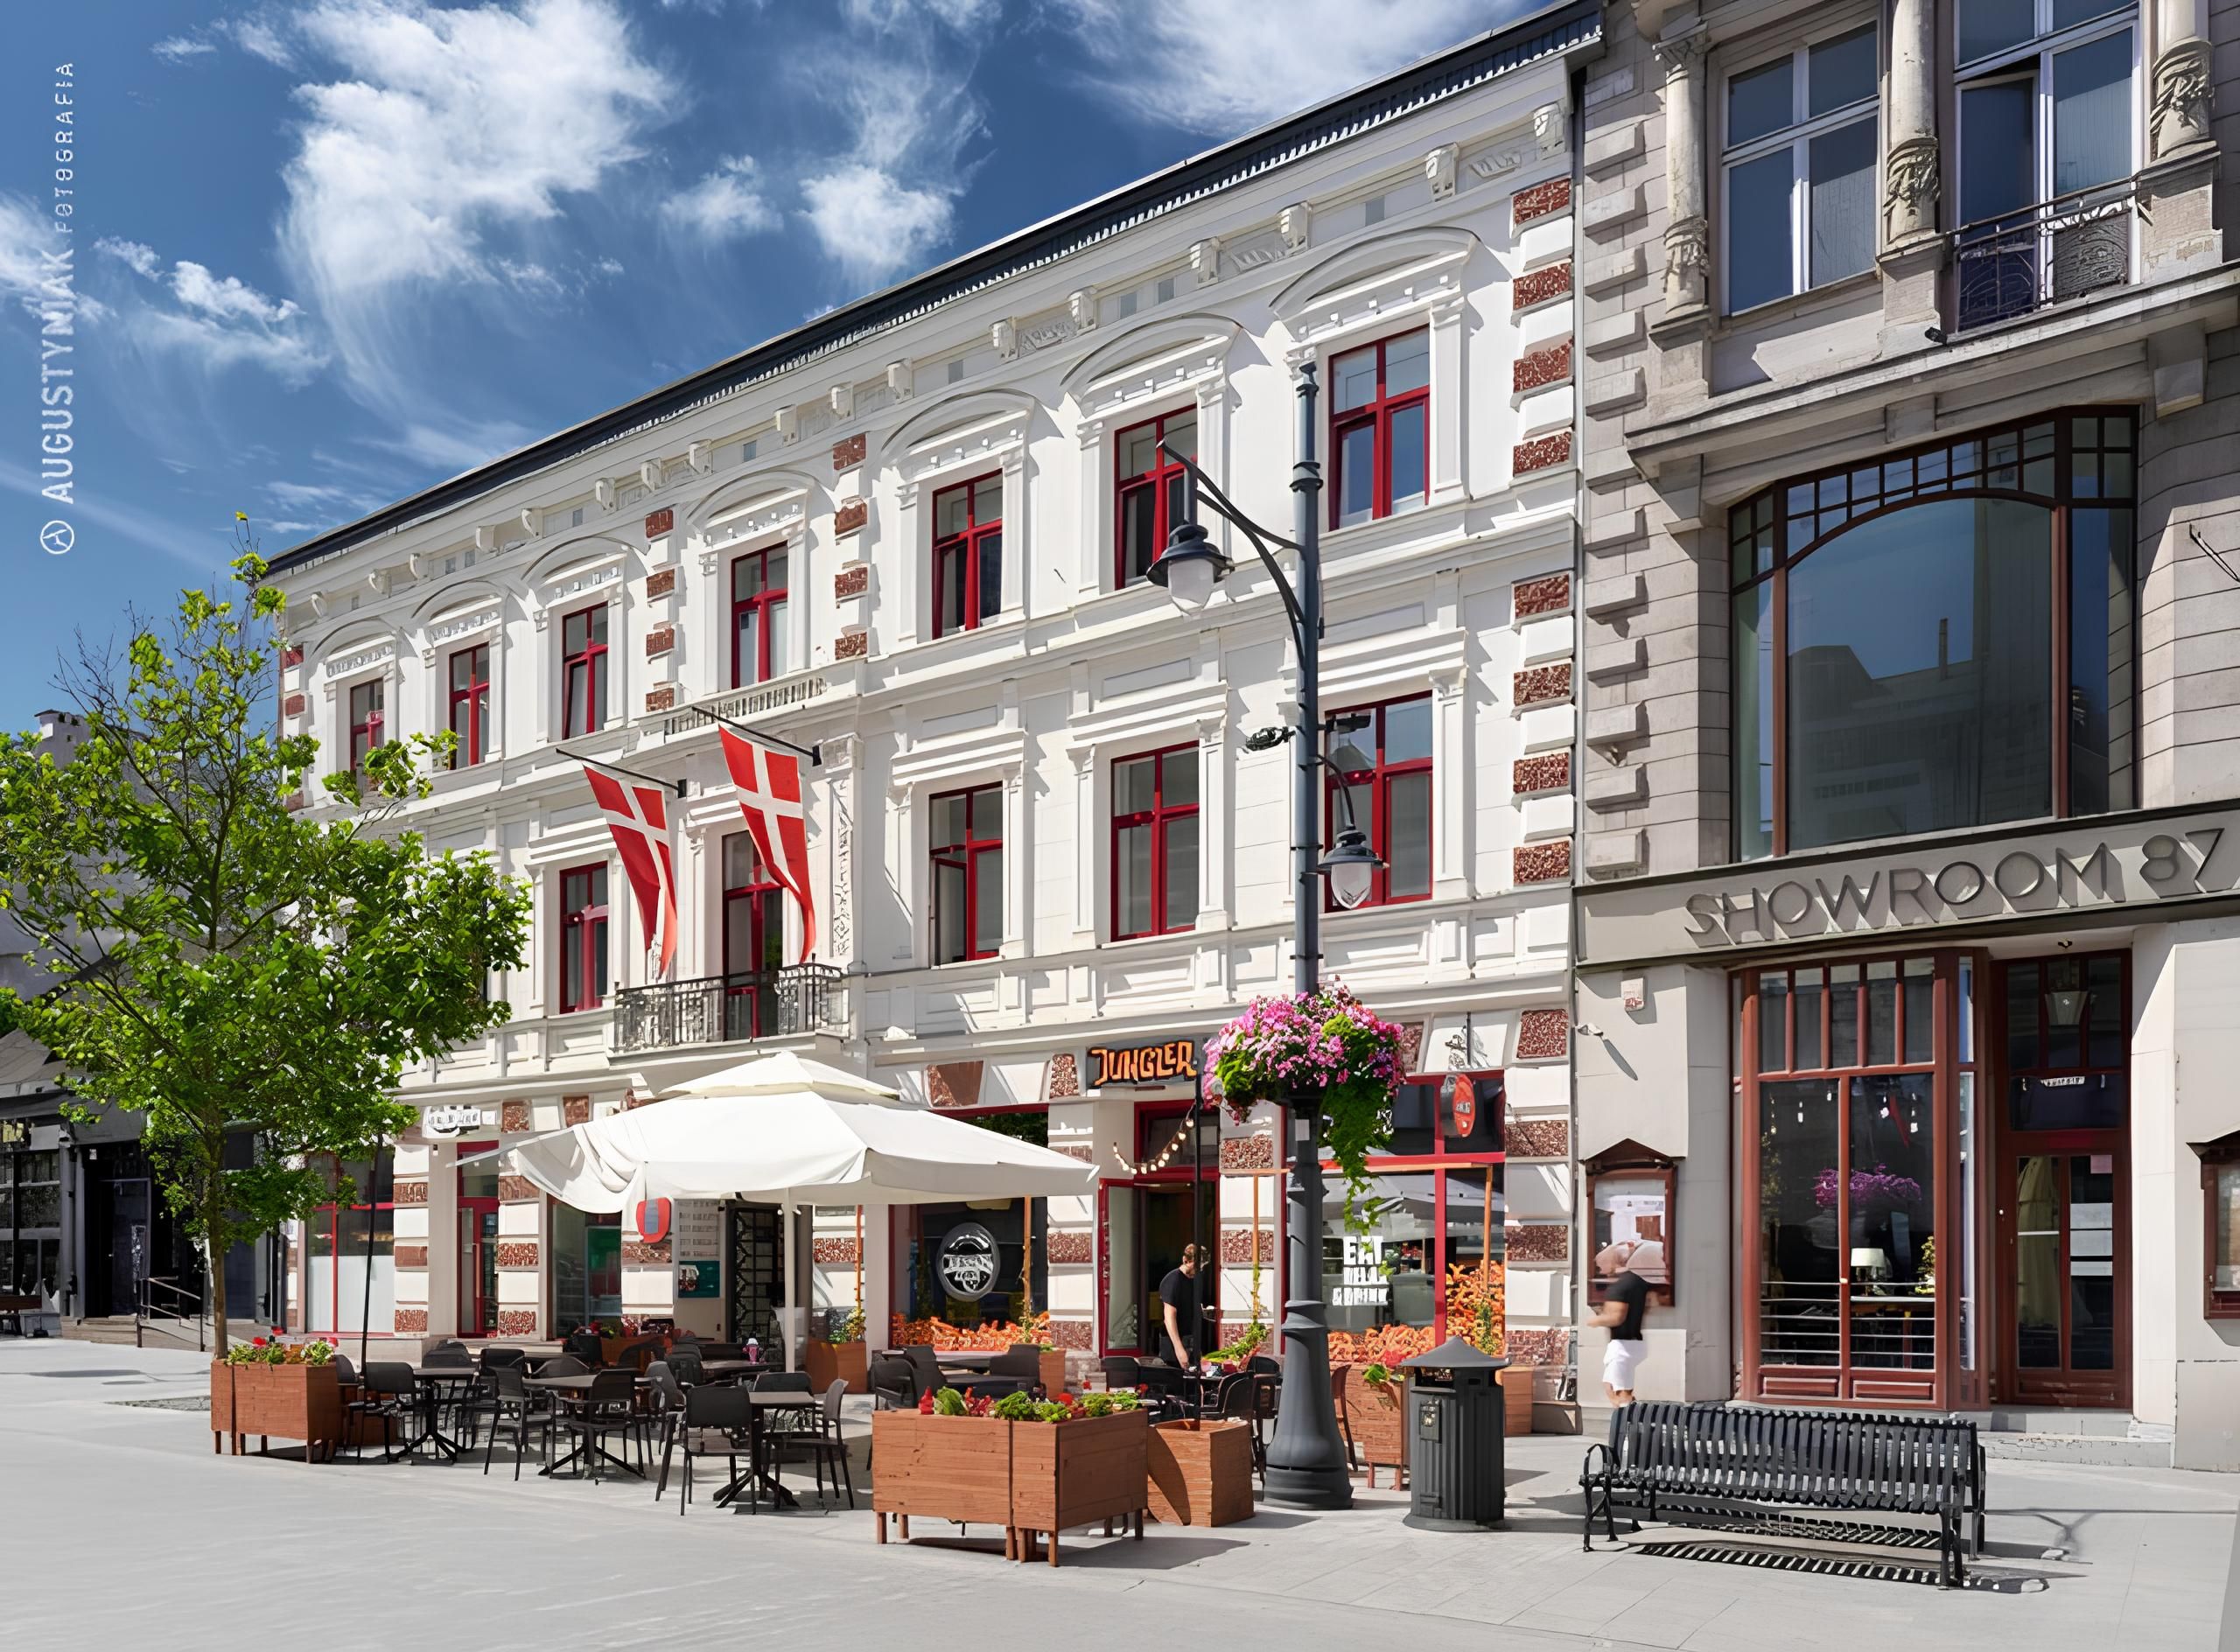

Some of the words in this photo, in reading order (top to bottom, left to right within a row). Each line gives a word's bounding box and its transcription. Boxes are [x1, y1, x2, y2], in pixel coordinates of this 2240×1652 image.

[1684, 842, 2113, 936] SHOWROOM
[2139, 828, 2225, 883] 87
[1089, 1040, 1198, 1087] JUNGLER
